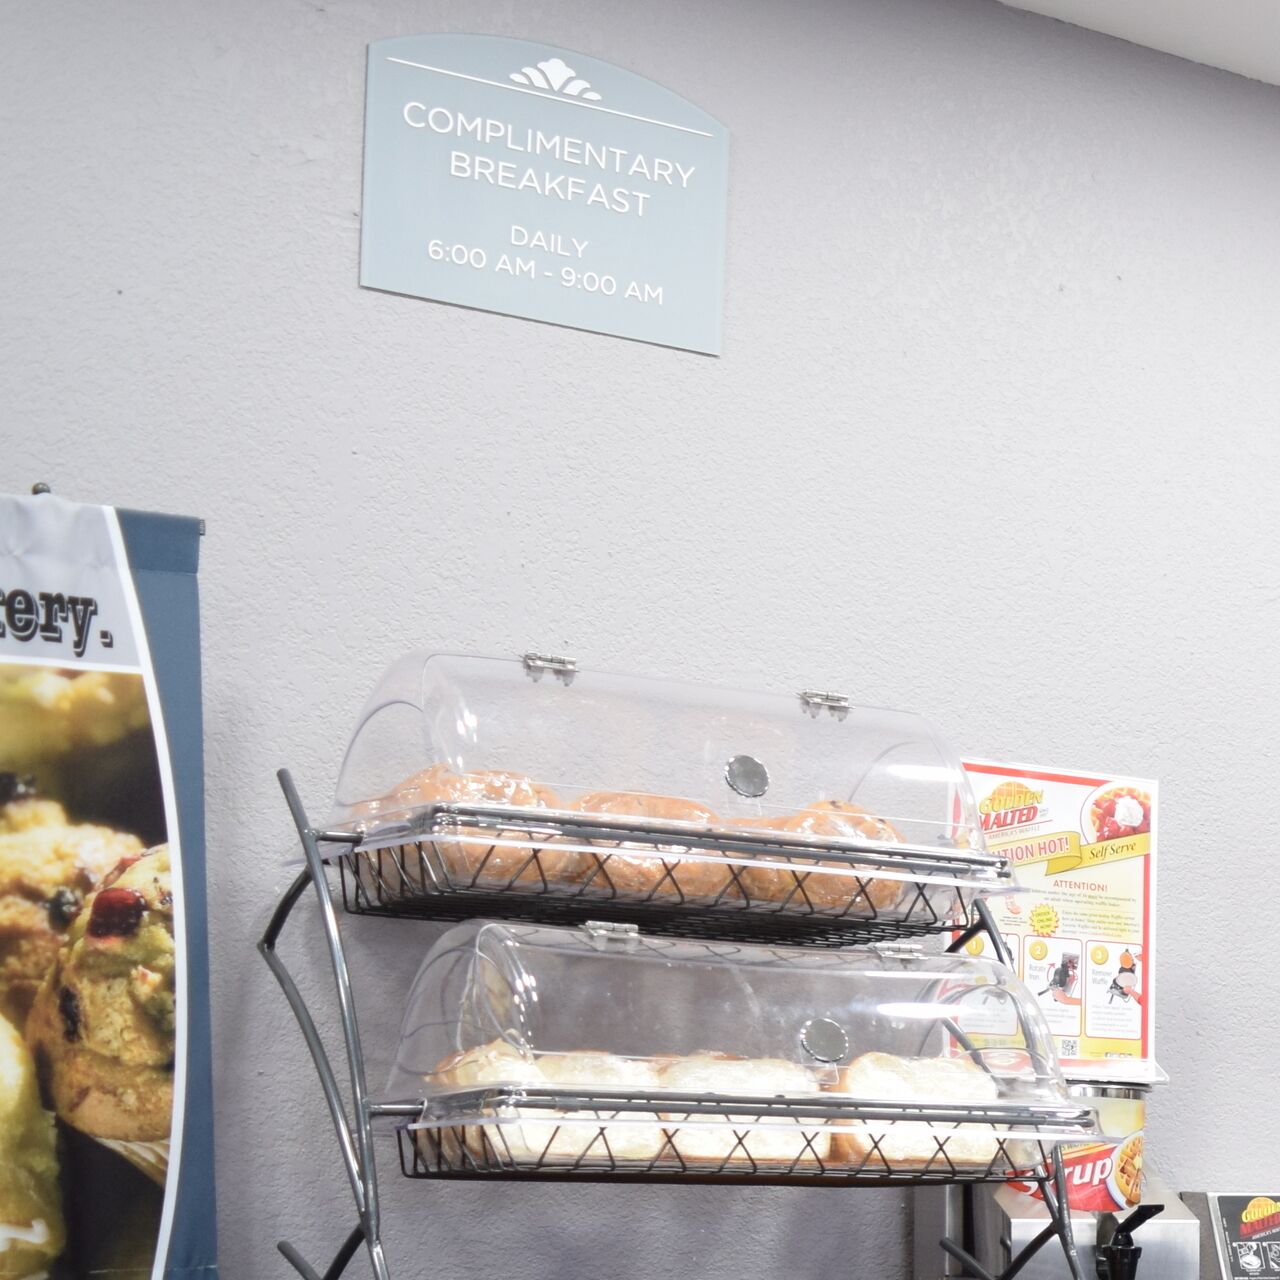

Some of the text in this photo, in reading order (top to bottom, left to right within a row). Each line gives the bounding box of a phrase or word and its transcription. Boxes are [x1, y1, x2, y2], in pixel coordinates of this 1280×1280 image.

[403, 101, 696, 188] COMPLIMENTARY
[451, 151, 650, 217] BREAKFAST
[511, 225, 588, 258] DAILY
[428, 240, 486, 269] 6:00
[495, 254, 535, 279] AM
[561, 267, 616, 295] 9:00
[624, 281, 663, 305] AM
[978, 789, 1044, 816] GOLDEN
[978, 805, 1039, 832] MALTED
[1038, 836, 1069, 857] HOT!
[1089, 842, 1136, 860] Self Serve
[1053, 880, 1108, 892] ATTENTION!
